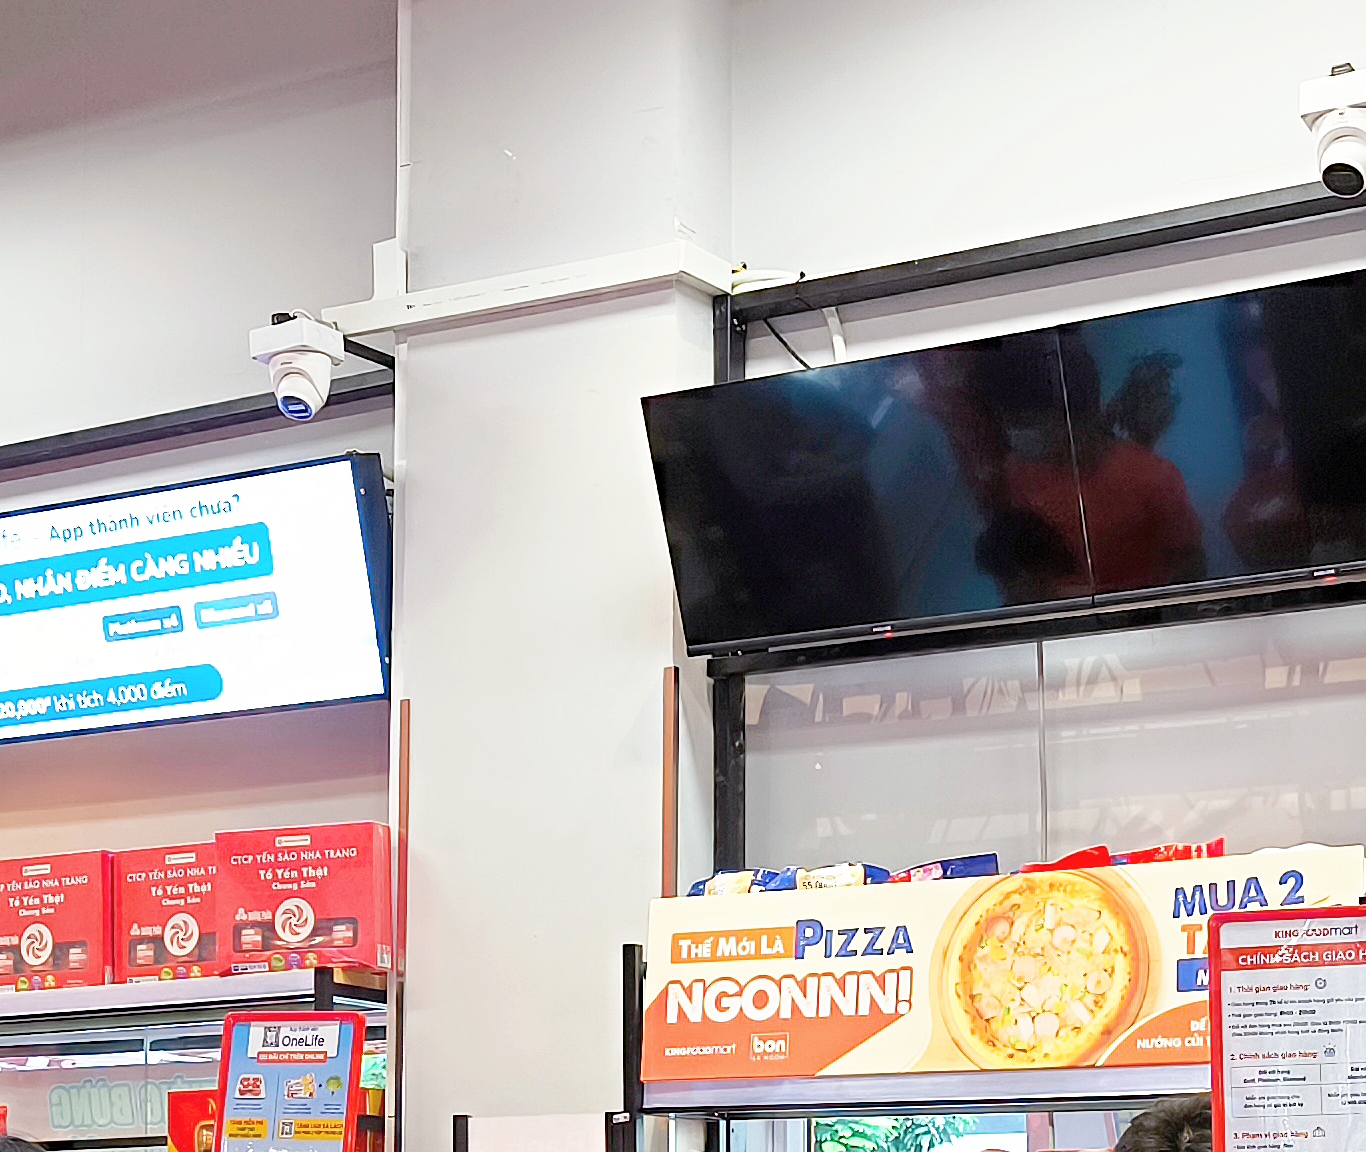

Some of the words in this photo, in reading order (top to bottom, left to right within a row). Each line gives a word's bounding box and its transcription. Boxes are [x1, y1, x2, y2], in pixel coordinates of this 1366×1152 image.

[50, 525, 83, 543] App
[130, 551, 189, 582] CÀNG
[54, 693, 75, 713] khi
[77, 689, 104, 709] tích
[107, 683, 148, 706] 4,000
[301, 850, 321, 861] NHA
[325, 848, 358, 859] TRANG
[1173, 877, 1268, 918] MUA
[1279, 870, 1304, 906] 2
[795, 918, 914, 960] PIZZA
[1322, 949, 1355, 961] GIAO
[666, 966, 914, 1024] NGONNN!
[281, 1035, 325, 1048] OneLife
